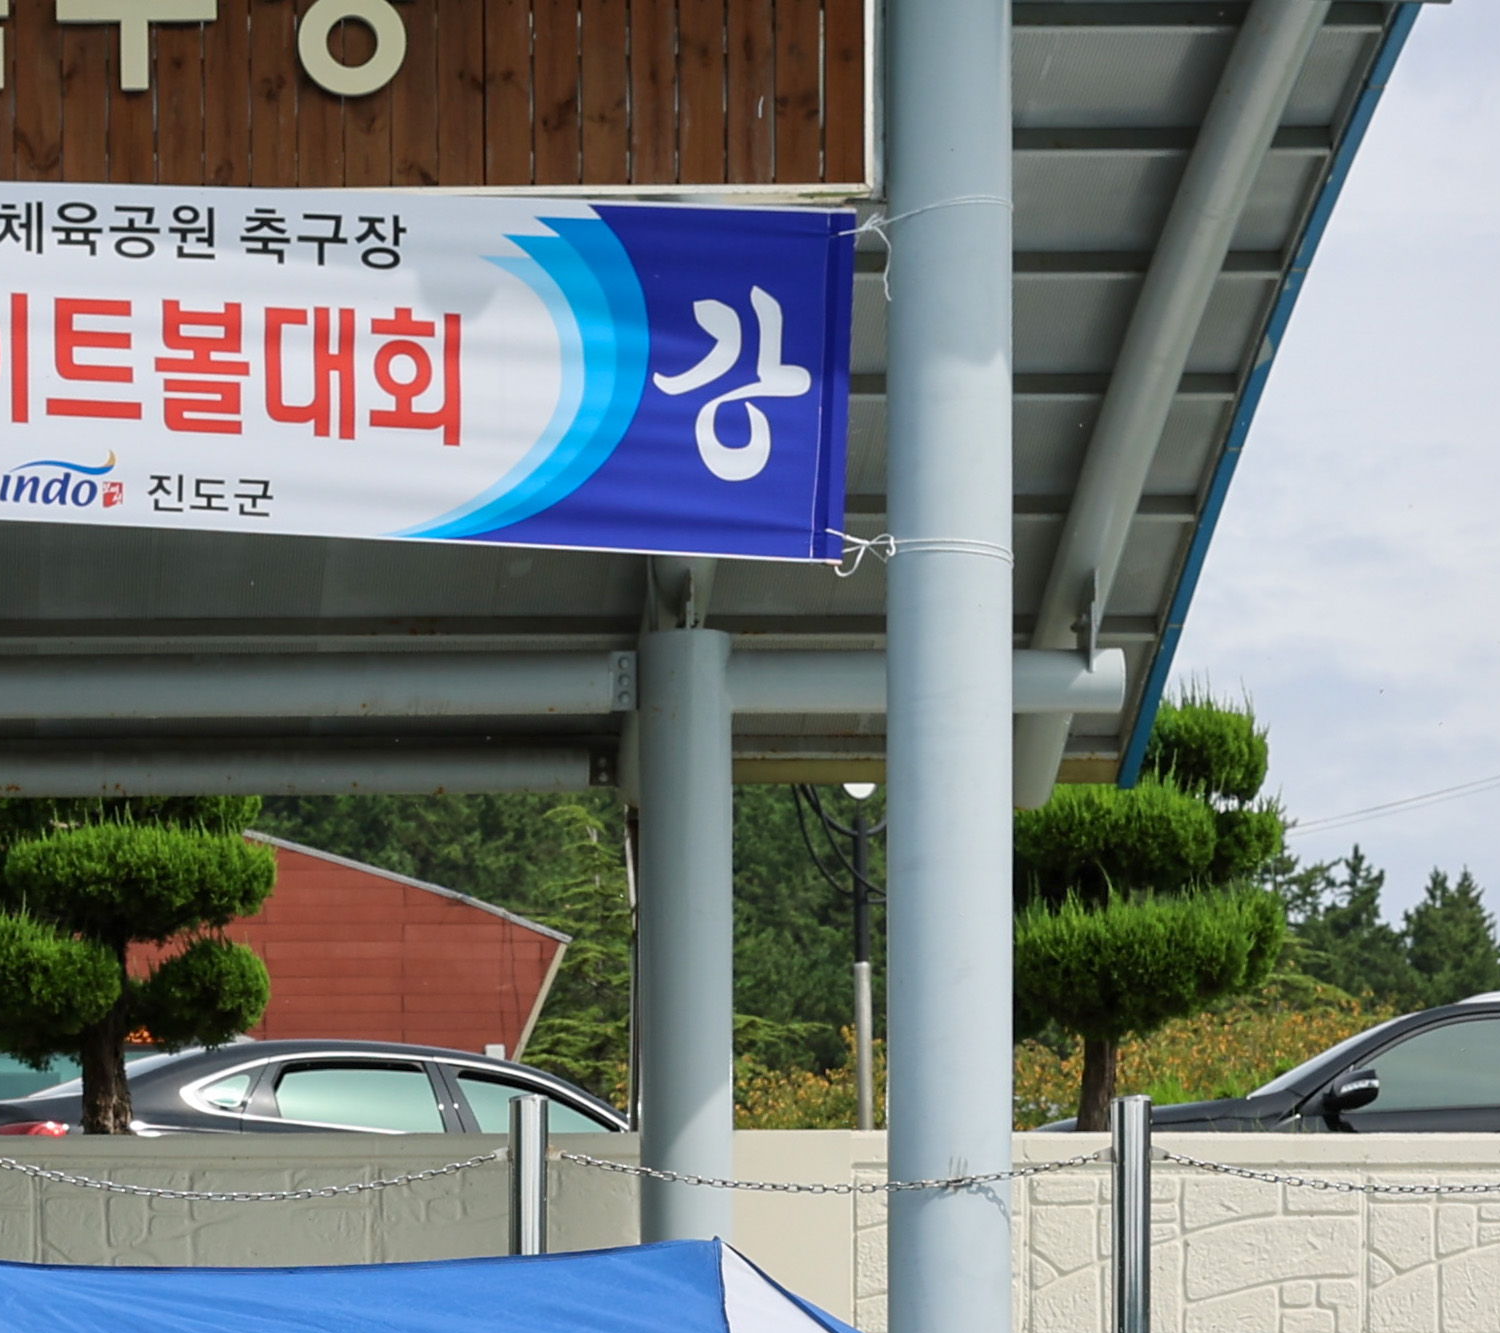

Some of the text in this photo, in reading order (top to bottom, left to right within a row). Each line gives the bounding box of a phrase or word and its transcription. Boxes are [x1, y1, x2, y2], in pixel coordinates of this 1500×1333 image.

[239, 207, 407, 270] 축구장
[653, 285, 812, 482] 강
[147, 474, 274, 517] 진도군
